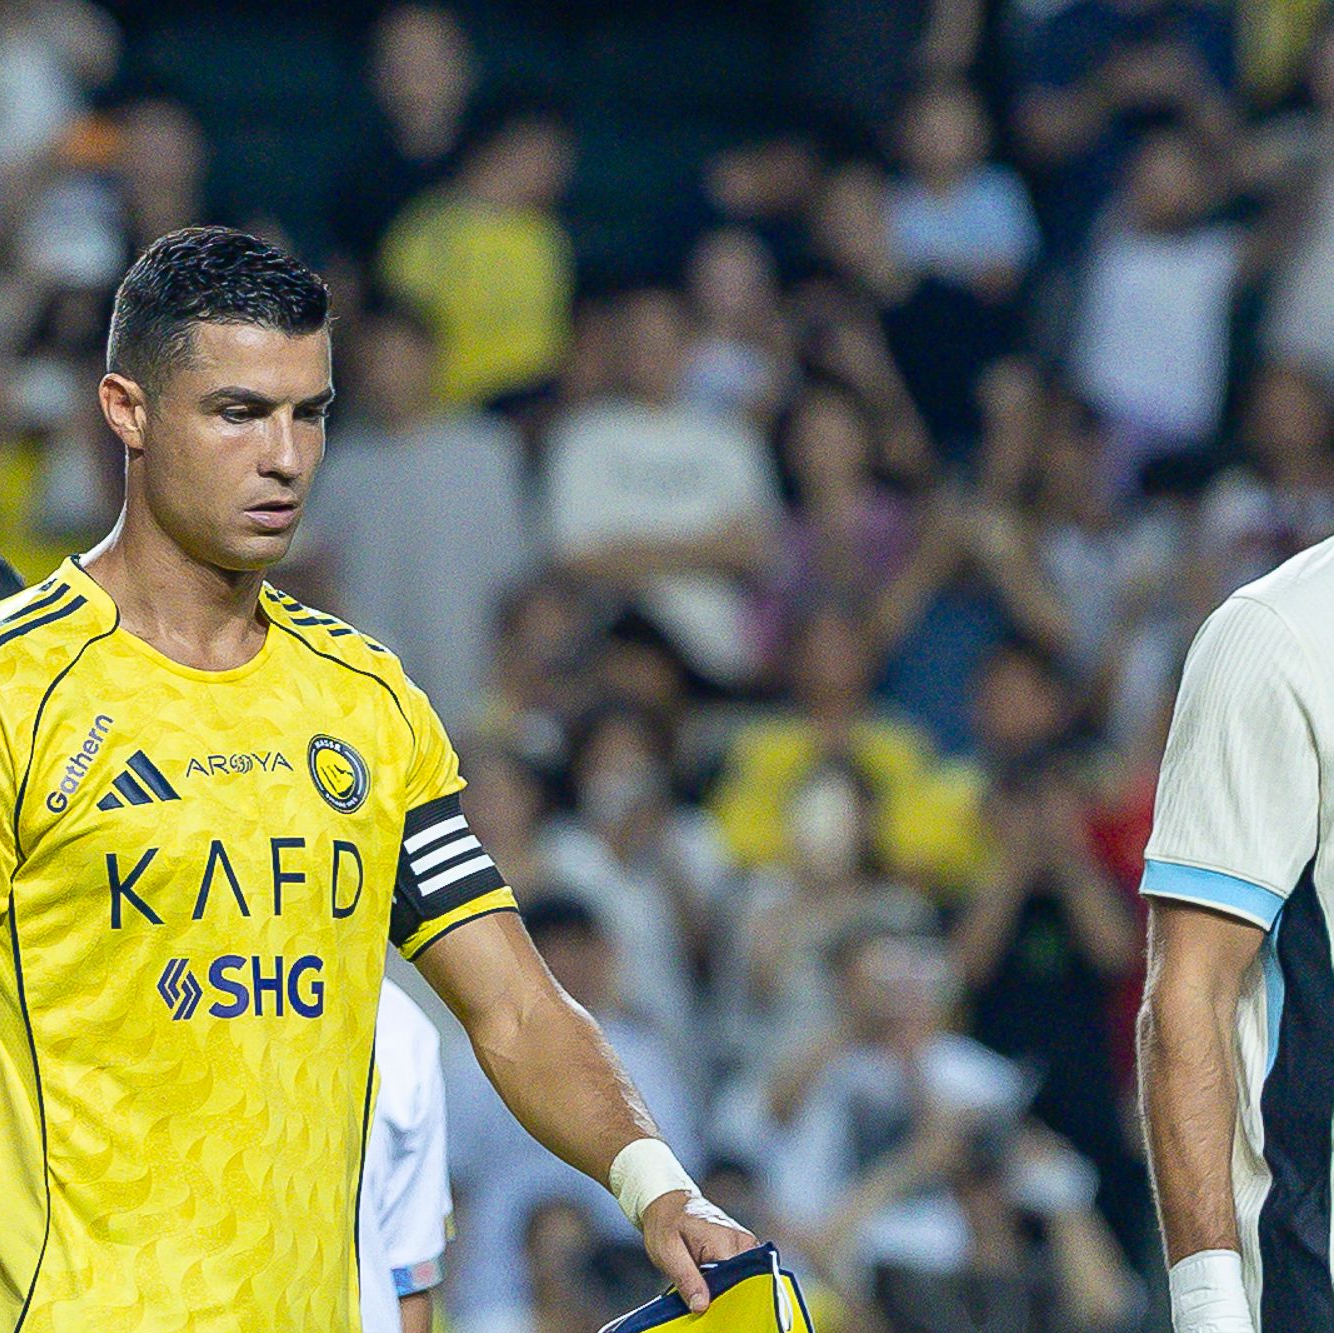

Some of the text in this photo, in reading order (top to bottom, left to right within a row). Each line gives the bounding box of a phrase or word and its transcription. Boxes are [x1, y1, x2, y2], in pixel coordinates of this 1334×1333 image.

[46, 713, 115, 814] Gathern
[105, 836, 365, 931] KAFD
[207, 953, 325, 1022] SHG
